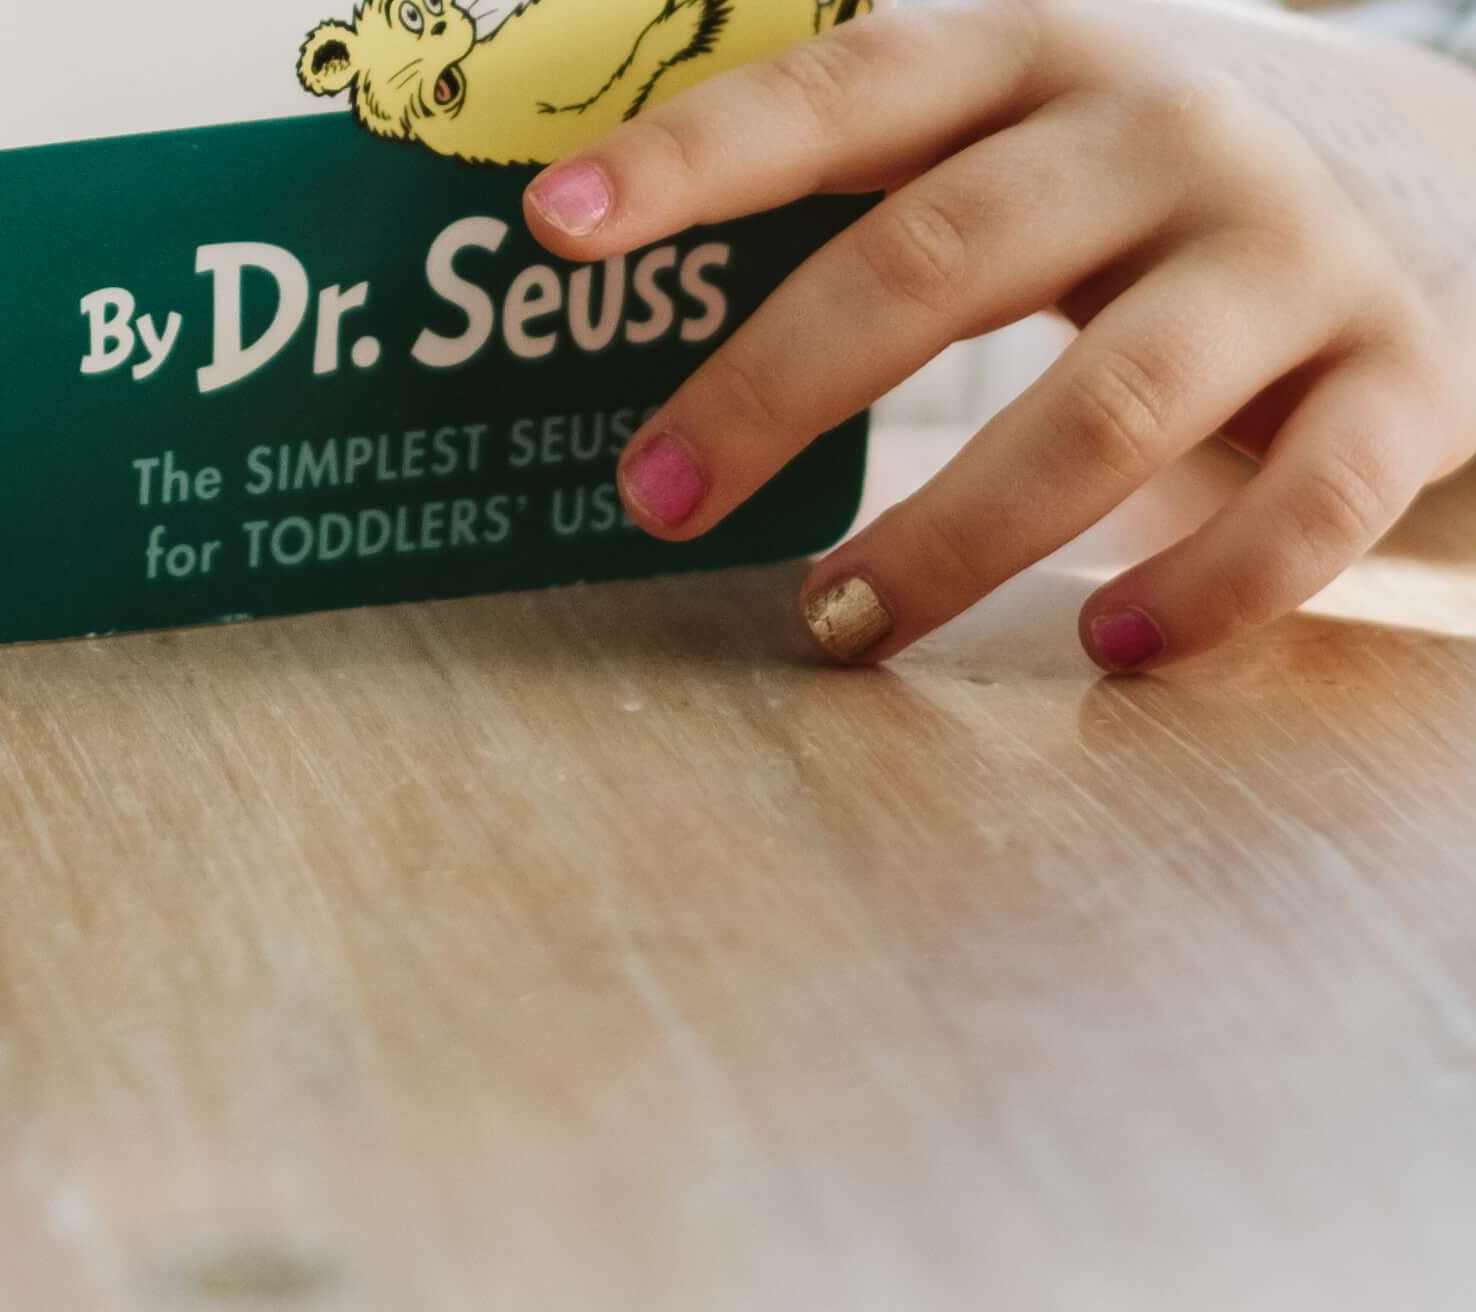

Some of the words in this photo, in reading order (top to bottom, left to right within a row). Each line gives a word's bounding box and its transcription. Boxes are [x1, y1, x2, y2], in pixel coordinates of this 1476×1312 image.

[80, 287, 182, 380] By
[195, 241, 380, 394] Dr.
[411, 215, 731, 368] Seuss
[132, 450, 222, 506] The
[245, 424, 487, 494] SIMPLEST
[510, 407, 654, 466] SEUS
[146, 525, 221, 579] for
[242, 496, 525, 568] TODDLERS'
